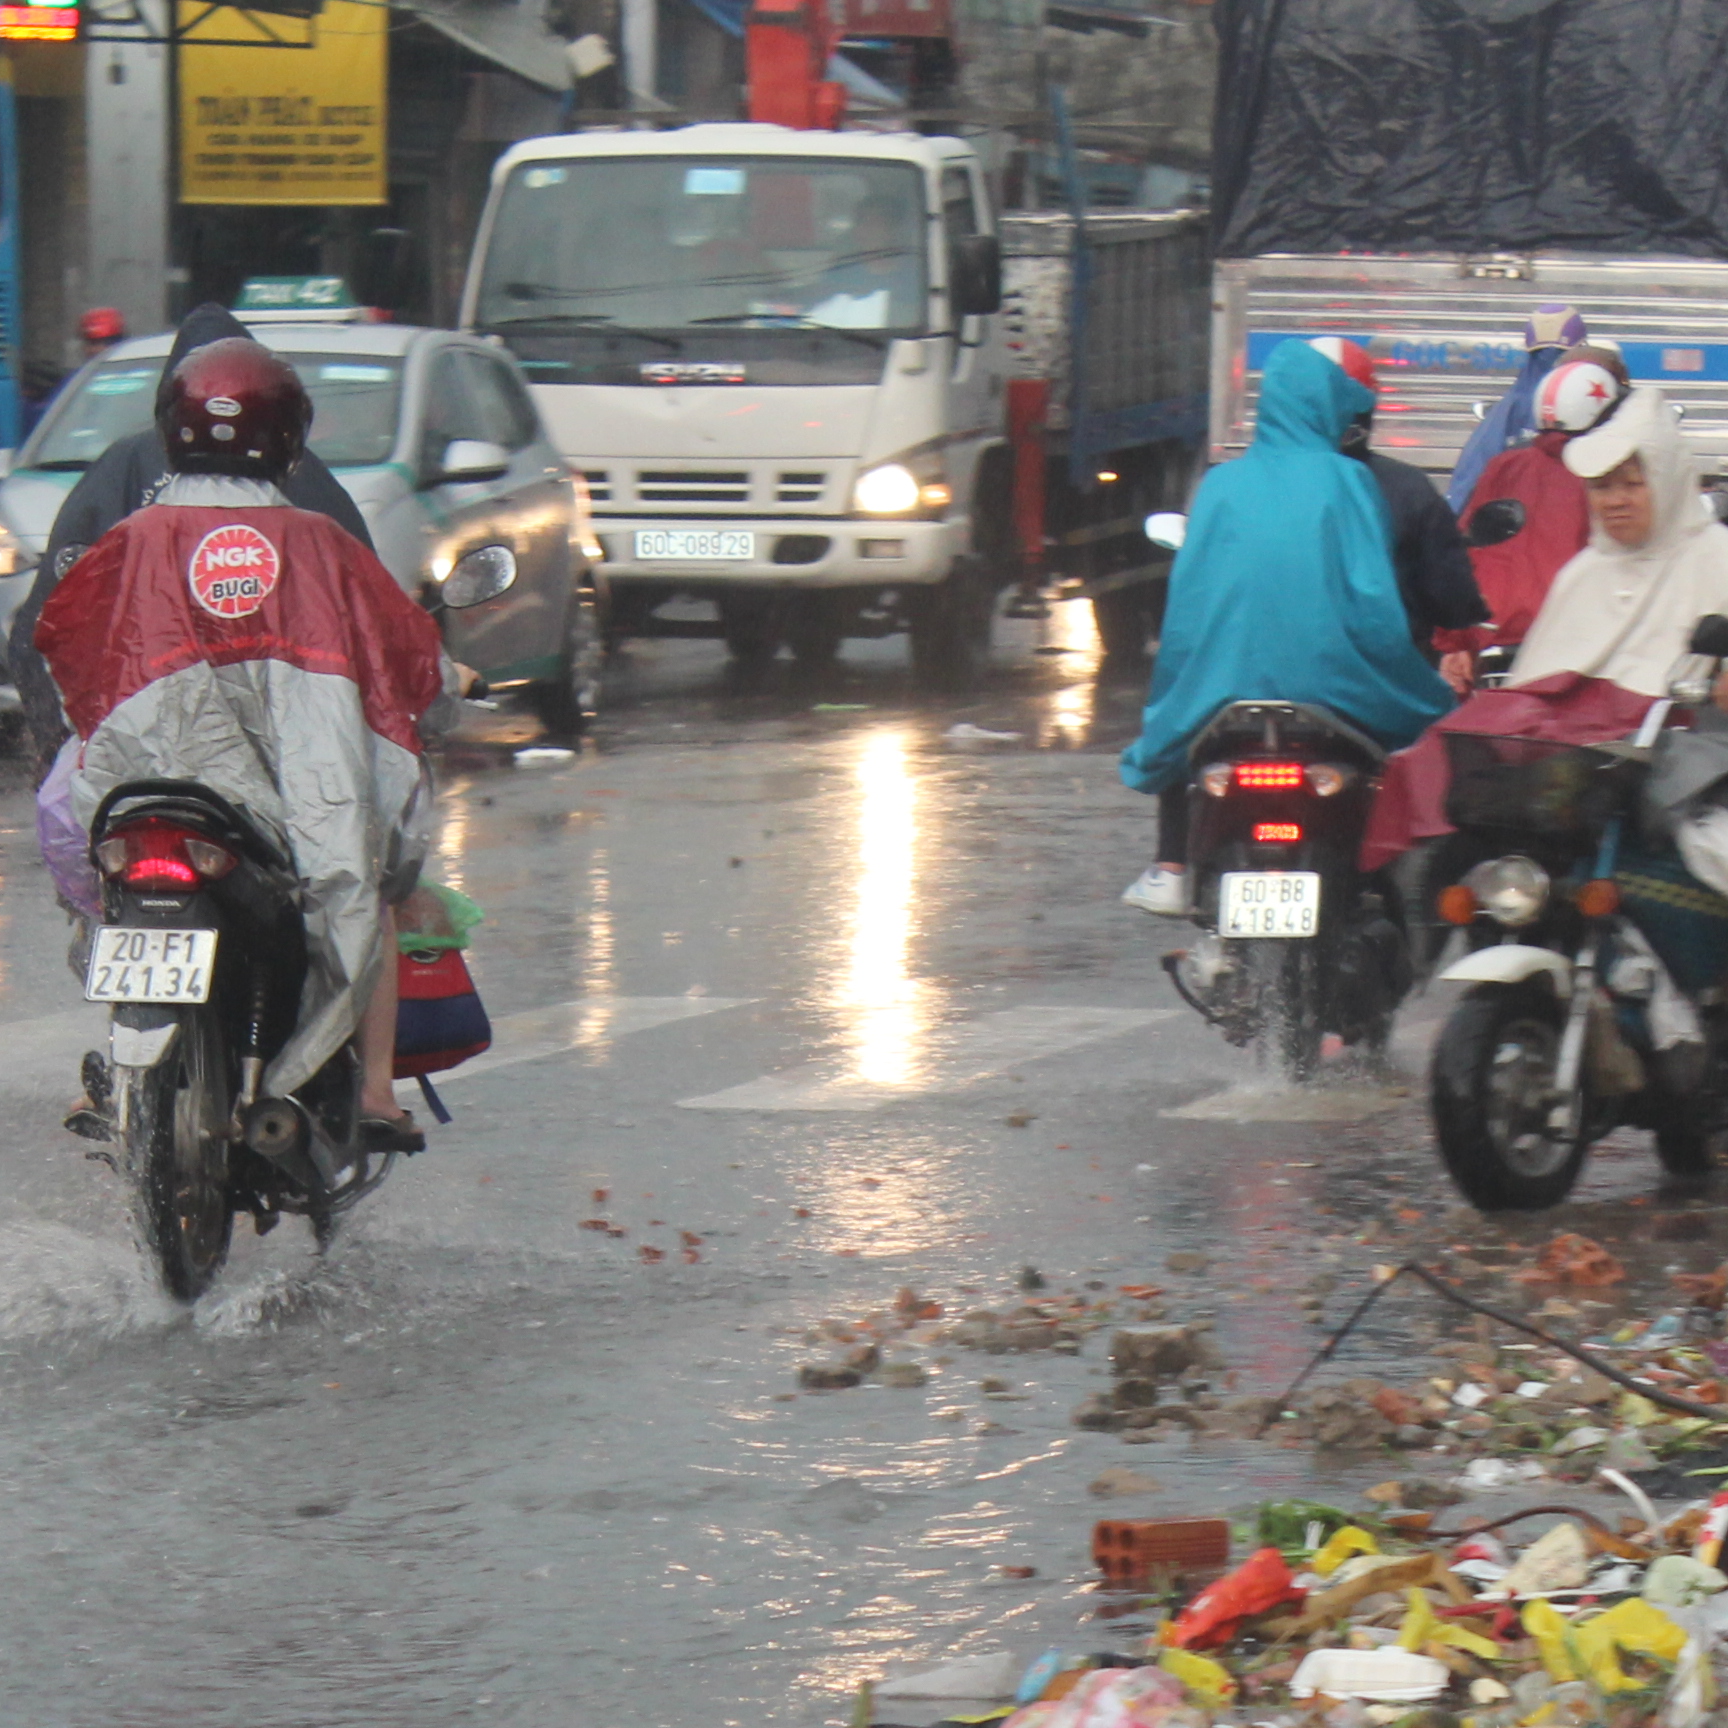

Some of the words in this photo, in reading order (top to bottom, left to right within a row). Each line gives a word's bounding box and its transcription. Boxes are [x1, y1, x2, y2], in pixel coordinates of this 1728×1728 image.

[205, 546, 264, 571] NGK
[211, 578, 260, 600] BUGI
[142, 899, 181, 907] HONDA
[1242, 879, 1305, 903] 60-B8
[112, 932, 196, 962] 20-F1
[94, 965, 201, 997] 241.34
